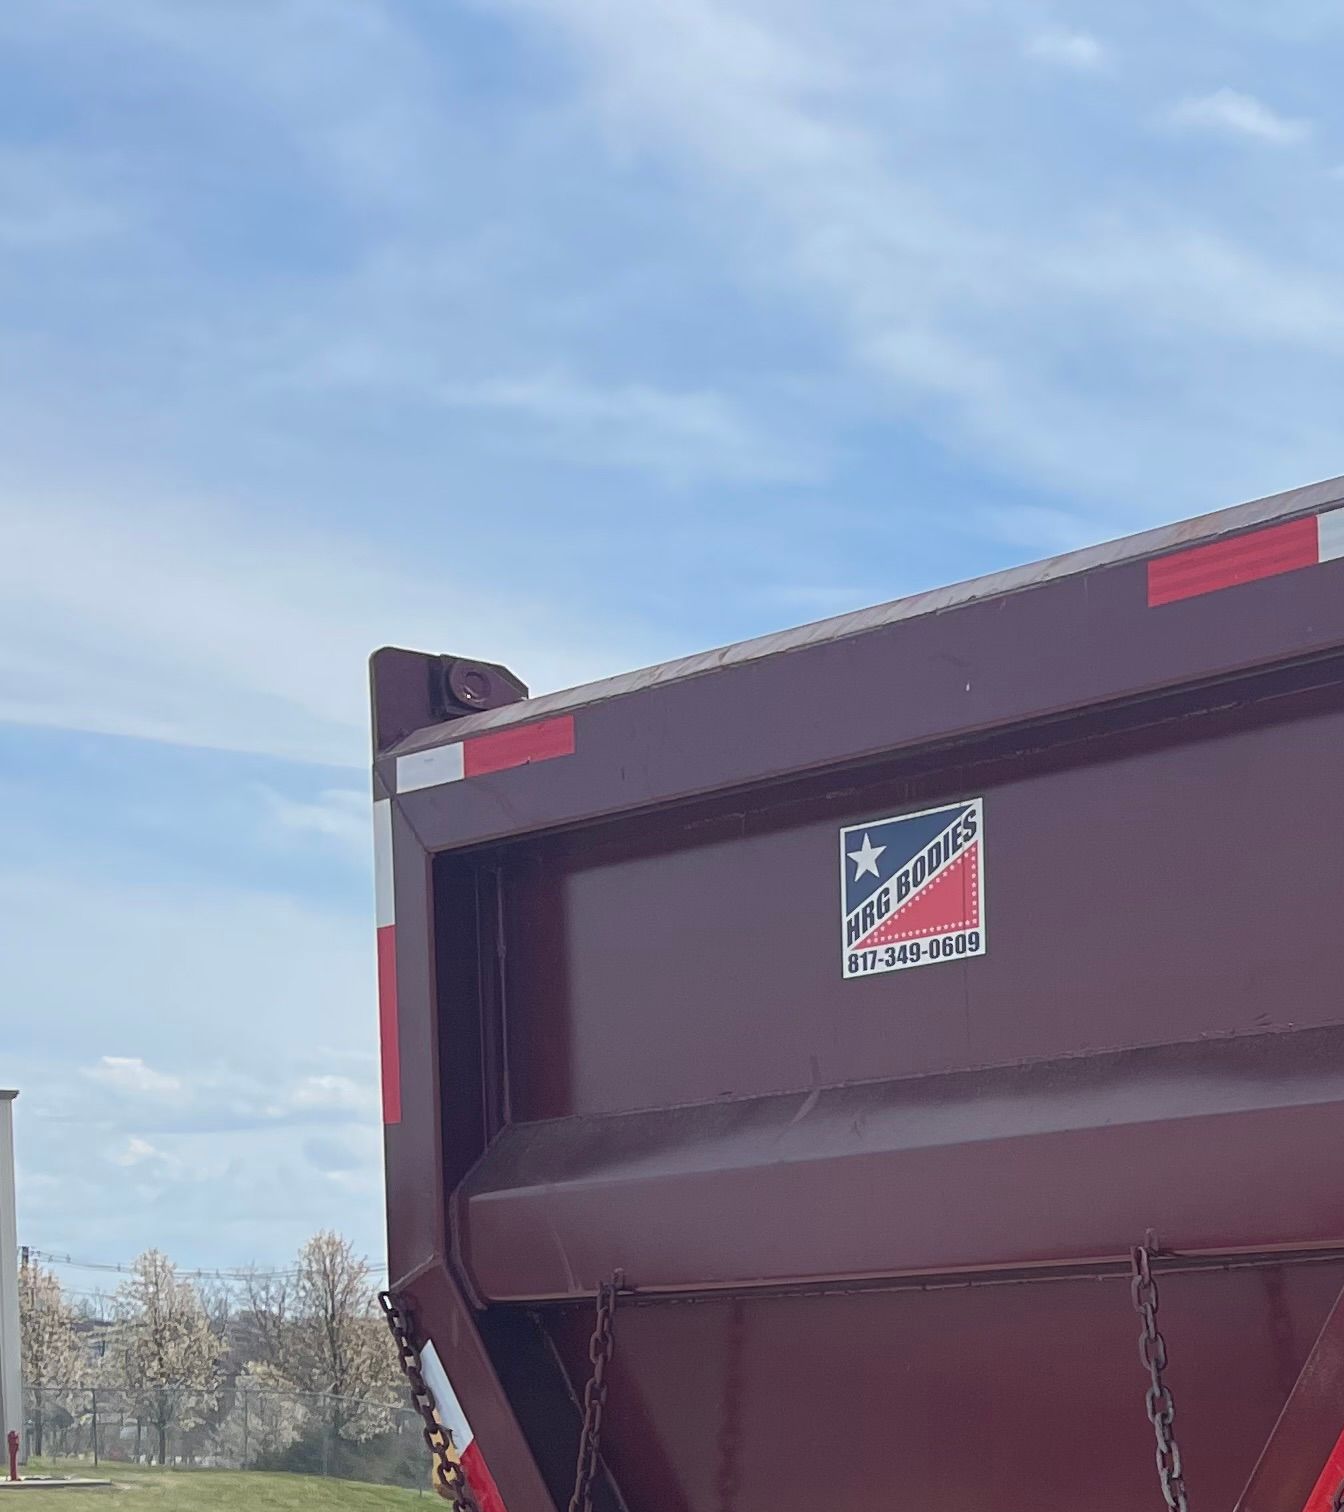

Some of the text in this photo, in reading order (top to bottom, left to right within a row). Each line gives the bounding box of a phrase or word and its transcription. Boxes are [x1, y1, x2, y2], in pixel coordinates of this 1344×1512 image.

[846, 809, 977, 948] HRG BODIES
[847, 931, 980, 973] 817-349-0609
